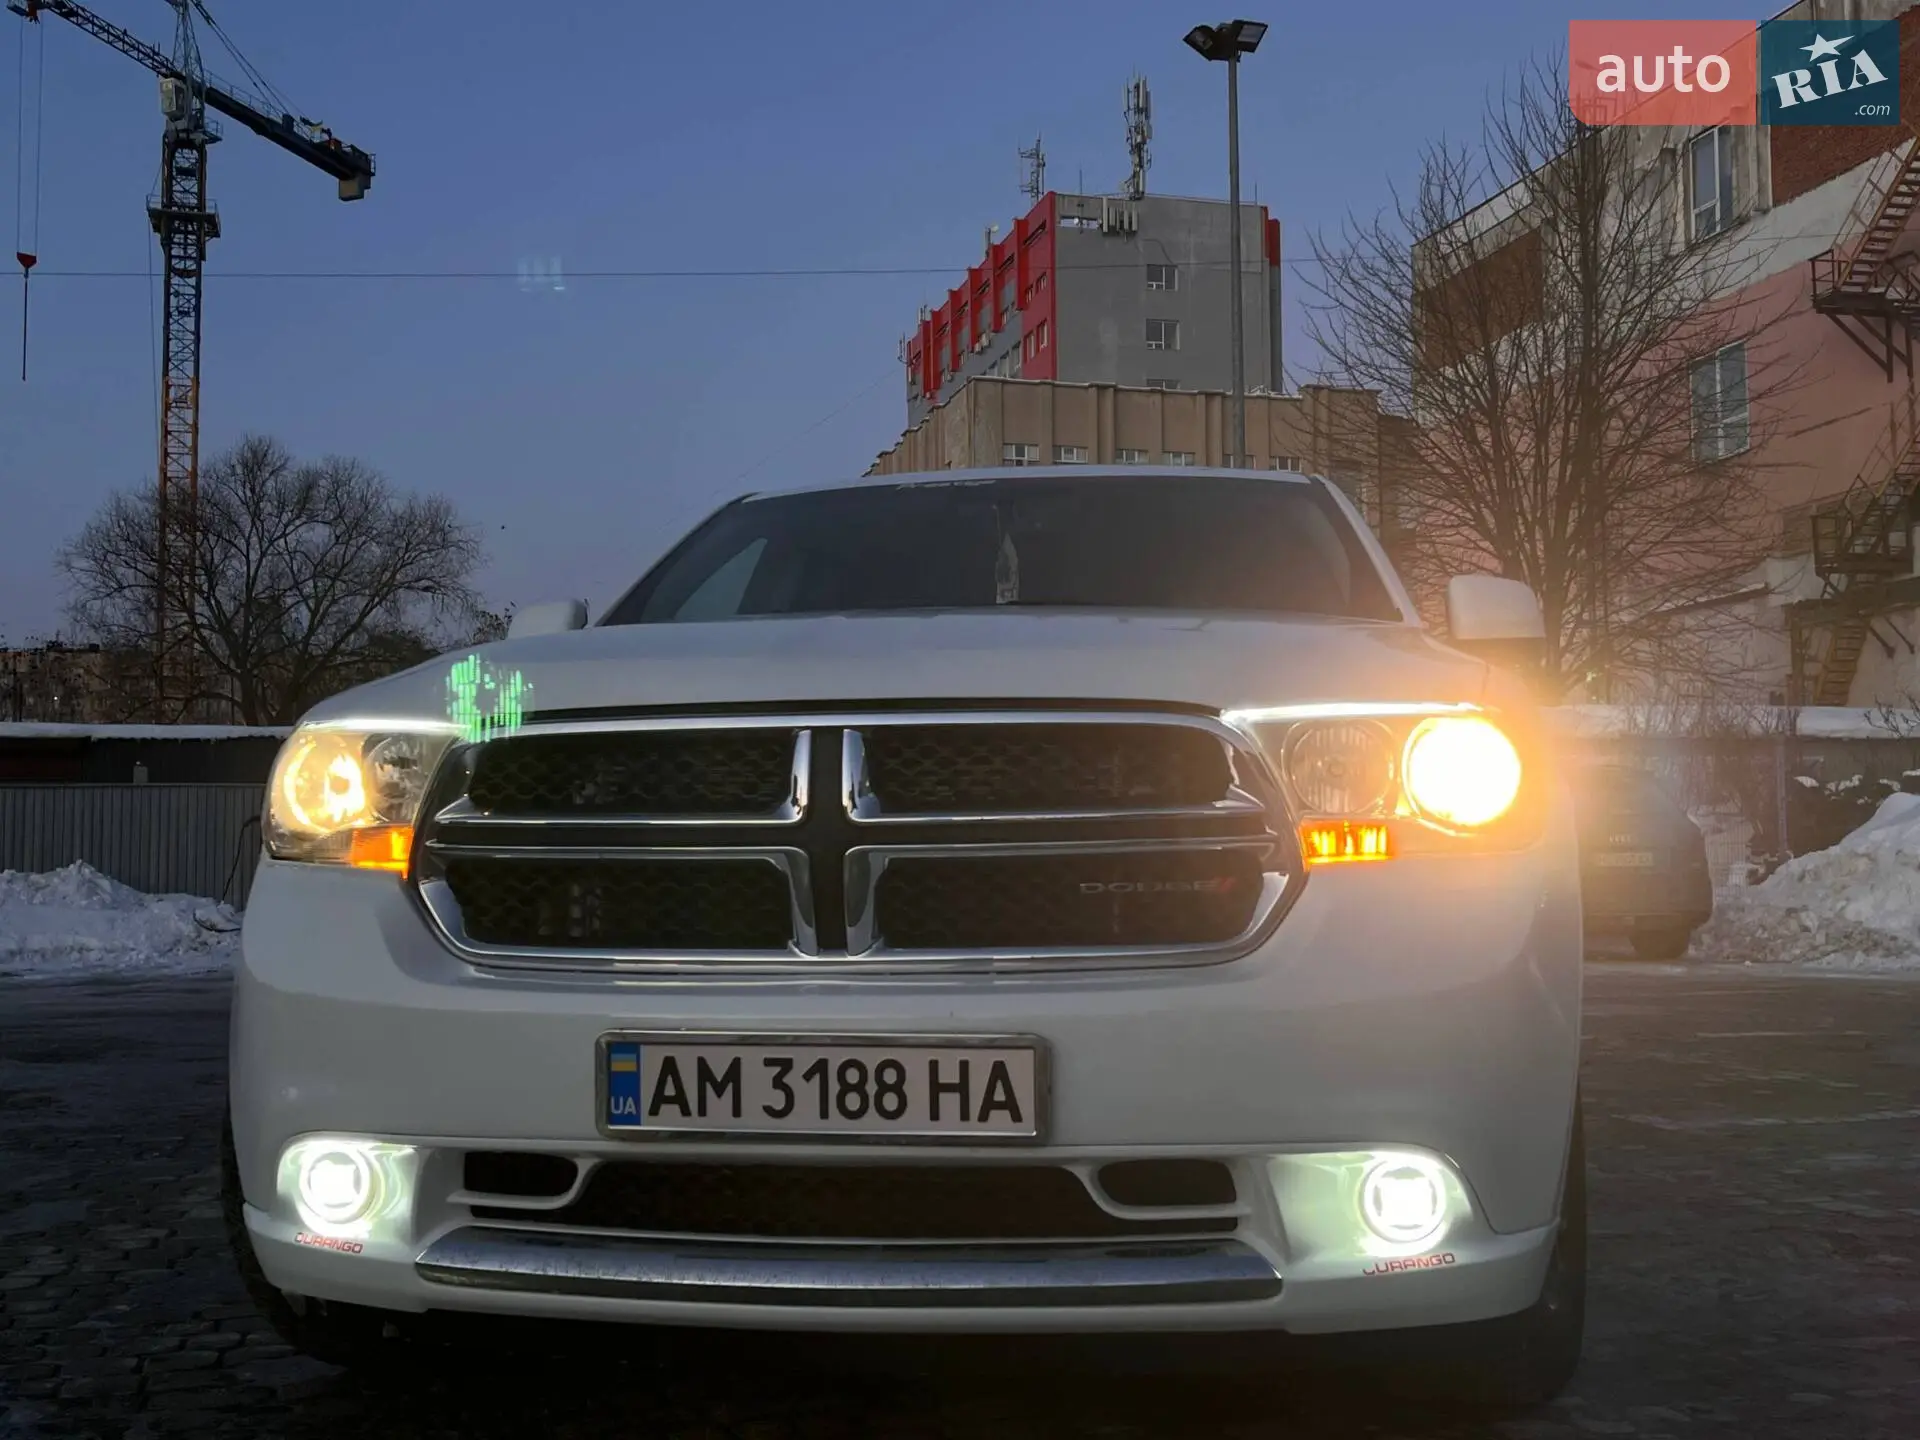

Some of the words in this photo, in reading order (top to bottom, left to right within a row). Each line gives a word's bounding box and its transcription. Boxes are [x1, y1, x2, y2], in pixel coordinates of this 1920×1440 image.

[610, 1095, 637, 1115] UA
[648, 1056, 742, 1118] AM
[762, 1058, 908, 1121] 3188
[928, 1059, 1023, 1123] HA
